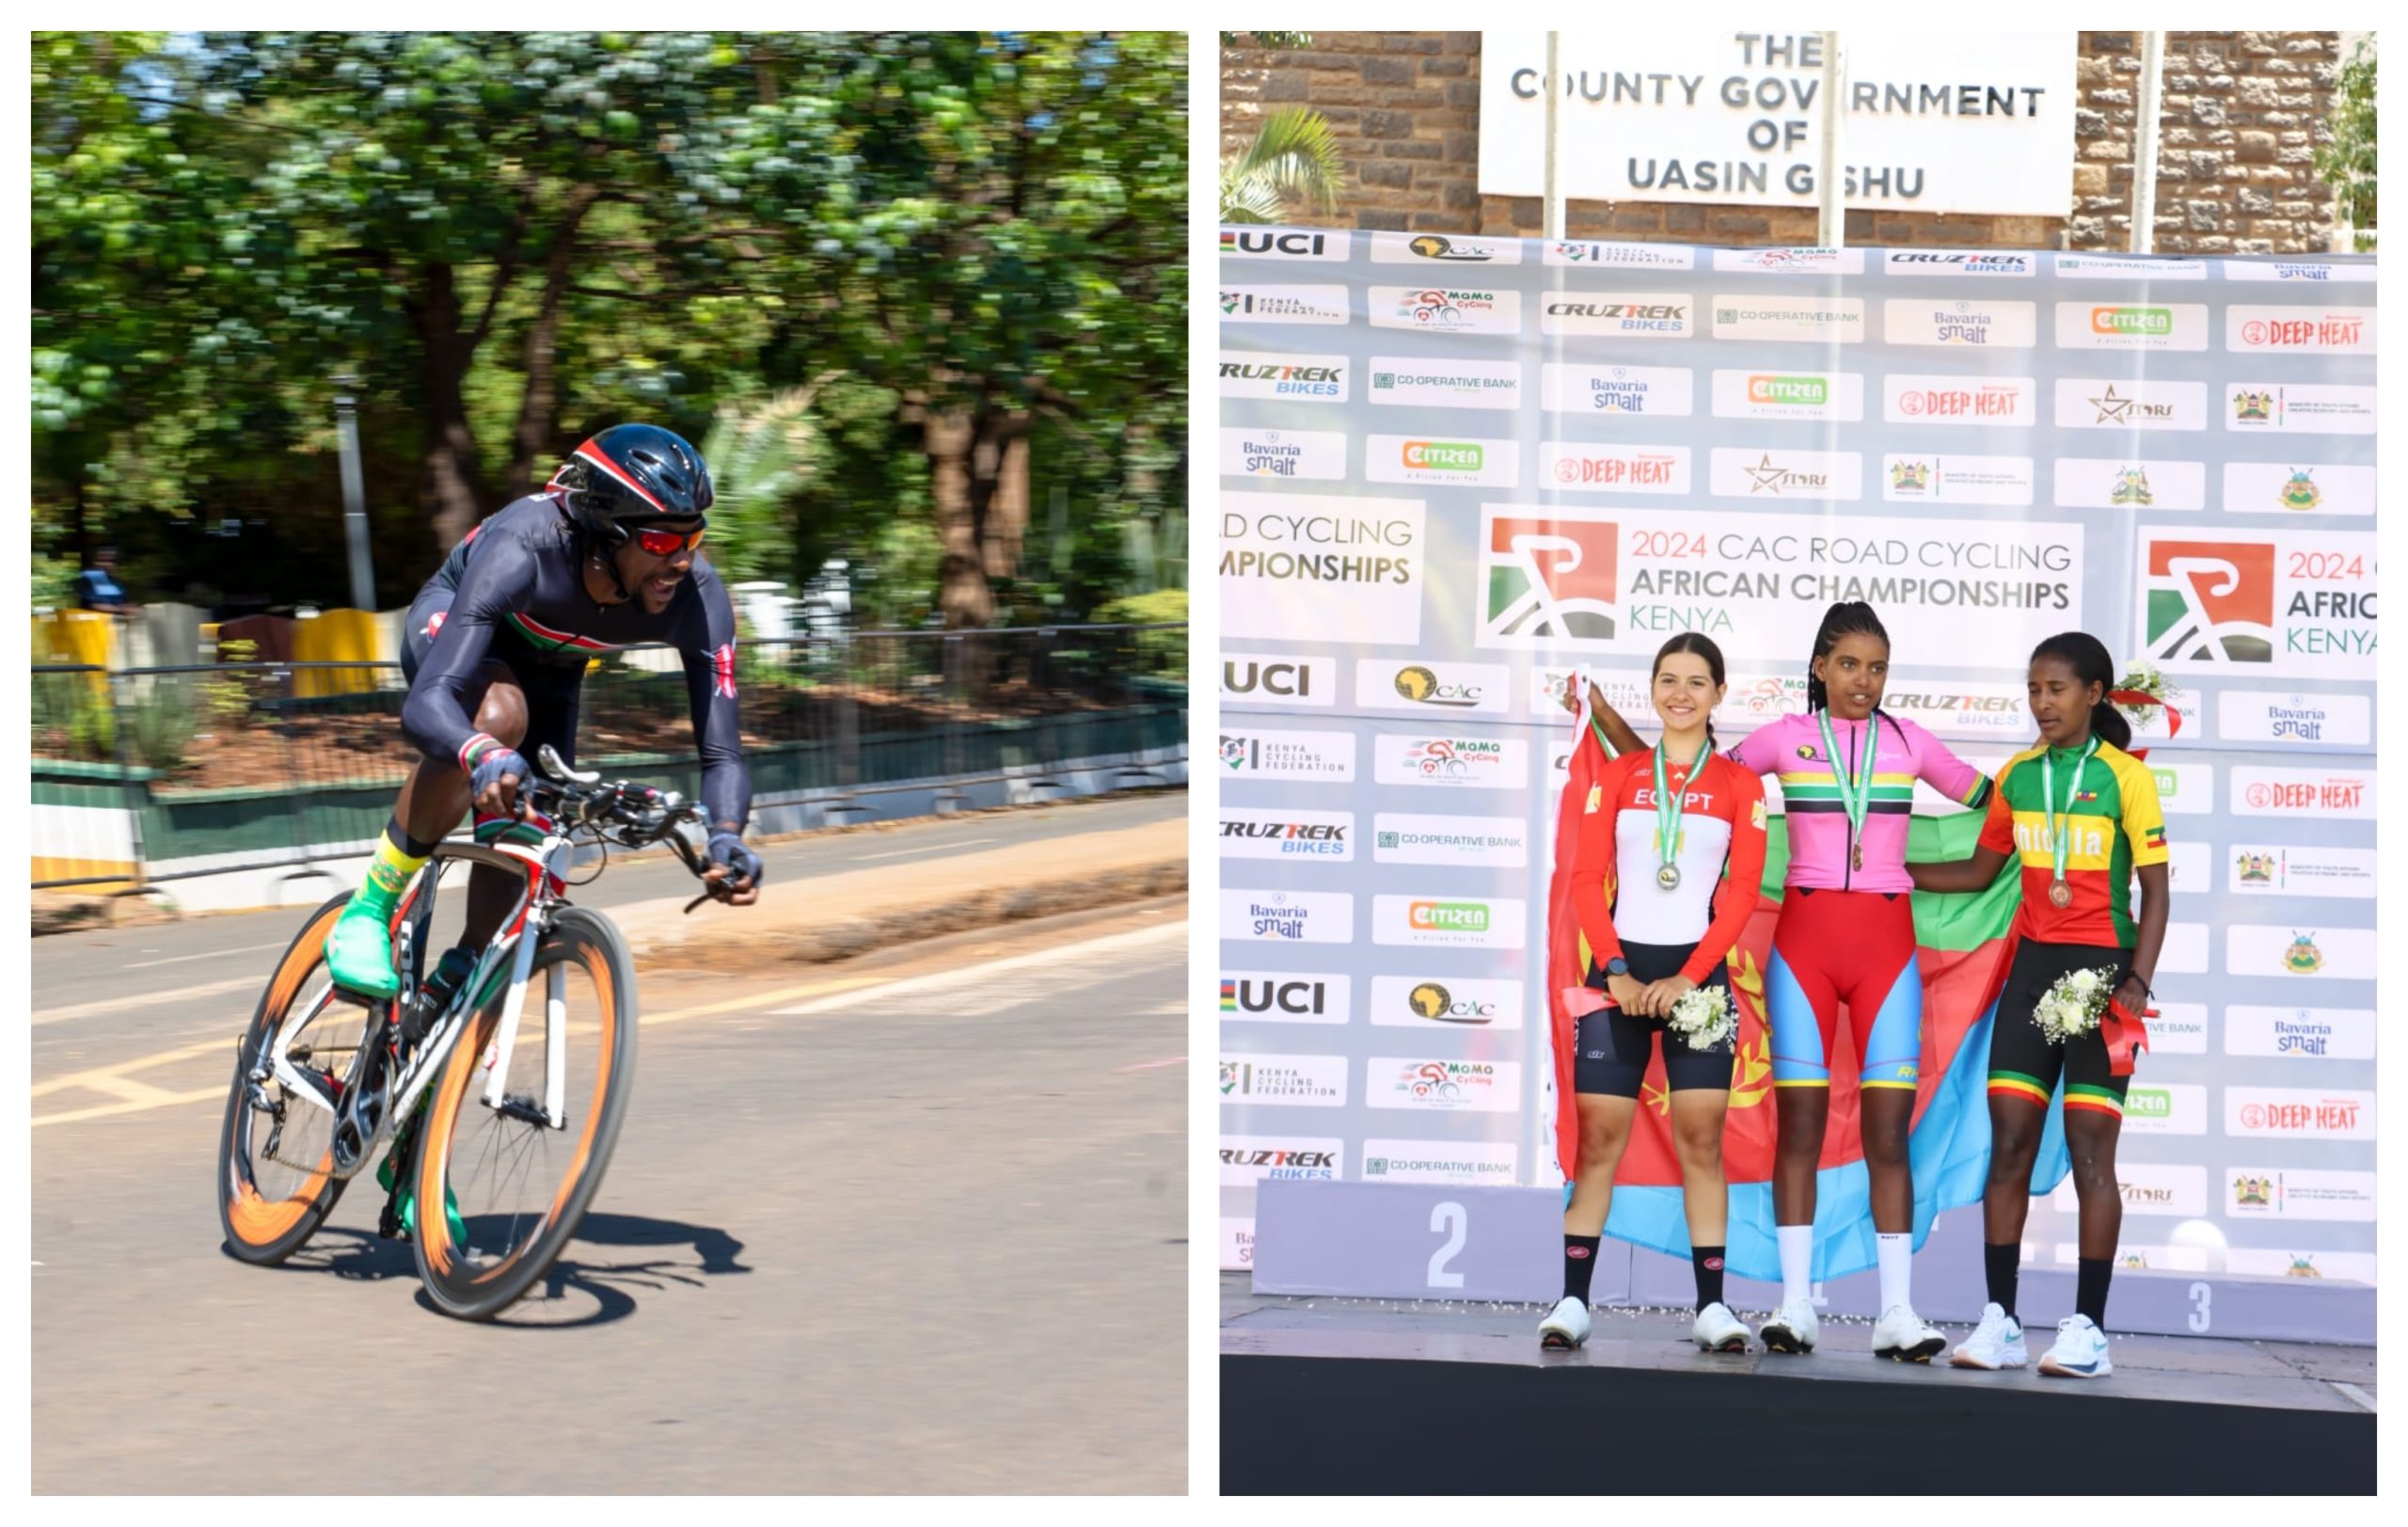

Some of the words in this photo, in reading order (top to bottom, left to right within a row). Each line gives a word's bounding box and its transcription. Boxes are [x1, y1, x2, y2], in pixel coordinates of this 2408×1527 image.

[1735, 34, 1823, 67] THE
[1720, 75, 2045, 117] GOVRNMENT
[1748, 119, 1807, 151] OF
[1627, 158, 1766, 193] UASIN
[1785, 164, 1925, 199] GSHU
[1240, 231, 1324, 256] UCI
[1450, 247, 1494, 256] CAC
[1964, 263, 2026, 273] BIKES
[2279, 268, 2329, 280] smalt
[1740, 310, 1824, 322] CO-OPERATIVE
[1826, 311, 1859, 323] BANK
[1934, 312, 1991, 325] Bavaria
[1621, 320, 1684, 331] BIKES
[2271, 320, 2313, 345] DEEP
[2319, 321, 2364, 345] HEAT
[1938, 325, 1987, 344] smalt
[1219, 362, 1342, 382] RUZTREK
[1276, 382, 1339, 395] BIKES
[1397, 374, 1481, 388] CO-OPERATIVE
[1483, 377, 1517, 390] BANK
[1591, 378, 1648, 392] Bavaria
[1594, 392, 1643, 412] smalt
[1927, 390, 1971, 416] DEEP
[1975, 391, 2020, 417] HEAT
[1243, 441, 1301, 456] Bavaria
[1246, 455, 1296, 476] smalt
[1581, 457, 1625, 484] DEEP
[1630, 459, 1675, 485] HEAT
[1220, 513, 1247, 538] D
[1258, 515, 1413, 547] CYCLING
[1631, 531, 1707, 559] 2024
[1718, 533, 1798, 563] CAC
[1810, 537, 1908, 565] ROAD
[1919, 541, 2071, 571] CYCLING
[2289, 551, 2364, 580] 2024
[1630, 568, 1780, 599] AFRICAN
[1791, 574, 2069, 611] CHAMPIONSHIPS
[1630, 605, 1734, 633] KENYA
[1224, 661, 1309, 696] UCI
[1435, 684, 1482, 699] CAC
[1602, 683, 1635, 692] ENYA
[1957, 711, 2020, 726] BIKES
[2269, 706, 2325, 721] Bavaria
[2273, 720, 2321, 740] smalt
[1266, 743, 1306, 753] KENYA
[1266, 753, 1321, 762] CYCLING
[1266, 761, 1345, 771] FEDERATION
[2273, 783, 2316, 808] DEEP
[2321, 785, 2365, 809] HEAT
[1281, 841, 1345, 854] BIKES
[1402, 834, 1484, 847] CO-OPERATIVE
[1487, 836, 1522, 848] BANK
[1250, 904, 1307, 919] Bavaria
[1254, 917, 1303, 939] smalt
[1240, 979, 1324, 1014] UCI
[1450, 1000, 1496, 1016] CAC
[2169, 1023, 2202, 1034] BANK
[2274, 1021, 2332, 1035] Bavaria
[2278, 1035, 2326, 1056] smalt
[1259, 1068, 1298, 1077] KENYA
[1258, 1077, 1312, 1087] CYCLING
[1258, 1086, 1337, 1096] FEDERATION
[2268, 1104, 2311, 1129] DEEP
[2317, 1105, 2360, 1130] HEAT
[1390, 1159, 1476, 1173] CO-OPERATIVE
[1478, 1162, 1512, 1173] BANK
[1270, 1169, 1332, 1180] BIKES
[1428, 1201, 1467, 1288] 2
[2189, 1282, 2211, 1332] 3
